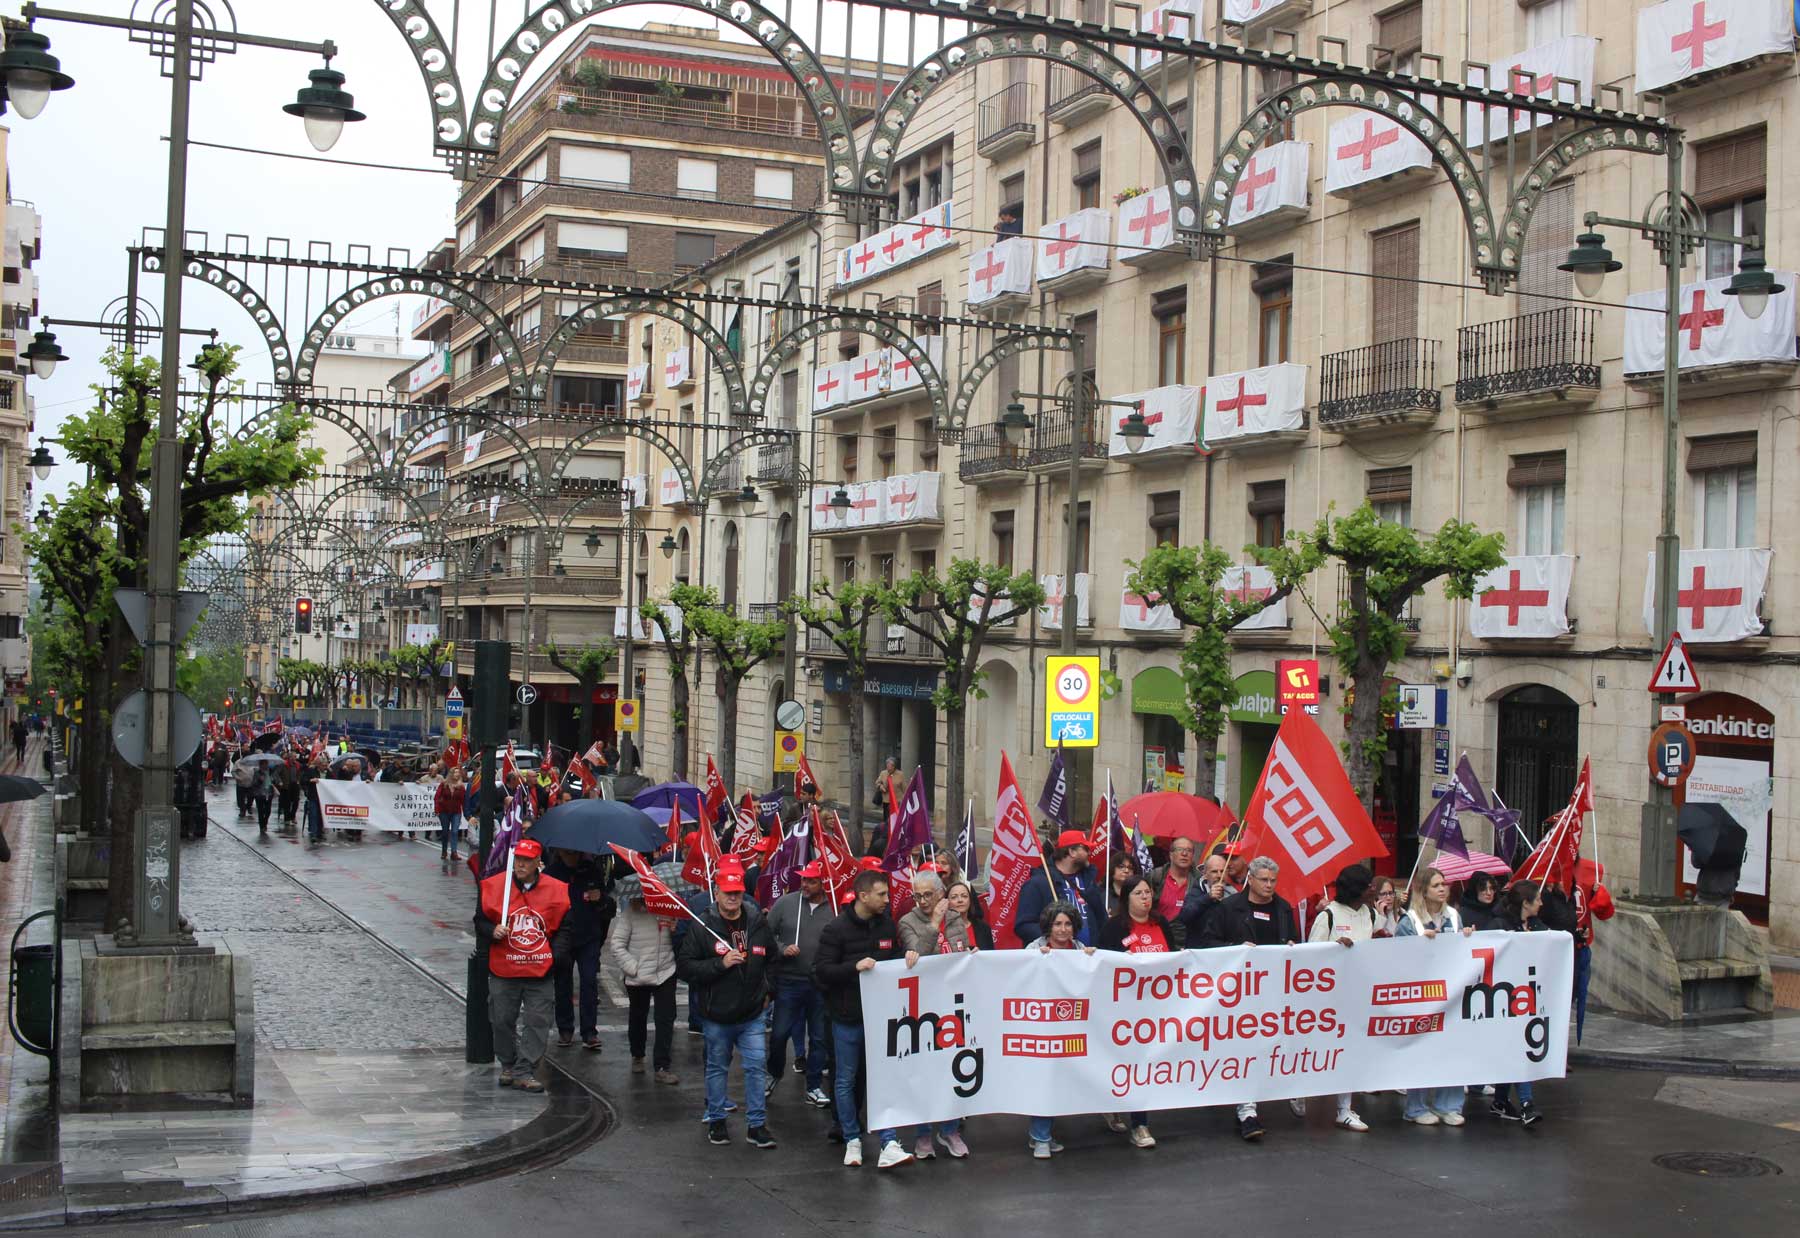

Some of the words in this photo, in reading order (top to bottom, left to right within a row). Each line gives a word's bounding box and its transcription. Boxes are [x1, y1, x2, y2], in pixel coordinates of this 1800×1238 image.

[1064, 678, 1082, 690] 30
[1283, 692, 1315, 700] TAACOS
[1667, 745, 1680, 763] P
[1689, 781, 1744, 795] RENTABILIDAD
[326, 806, 356, 814] CCOO
[1113, 961, 1269, 1008] Protegir
[1284, 959, 1336, 994] les
[1375, 985, 1423, 1002] CCOO
[1010, 1001, 1054, 1020] UGT
[1112, 1005, 1346, 1051] conquestes,
[1374, 1018, 1415, 1034] UGT
[1007, 1038, 1063, 1054] CCOO
[1111, 1056, 1257, 1097] guanyar
[1269, 1045, 1344, 1077] futur
